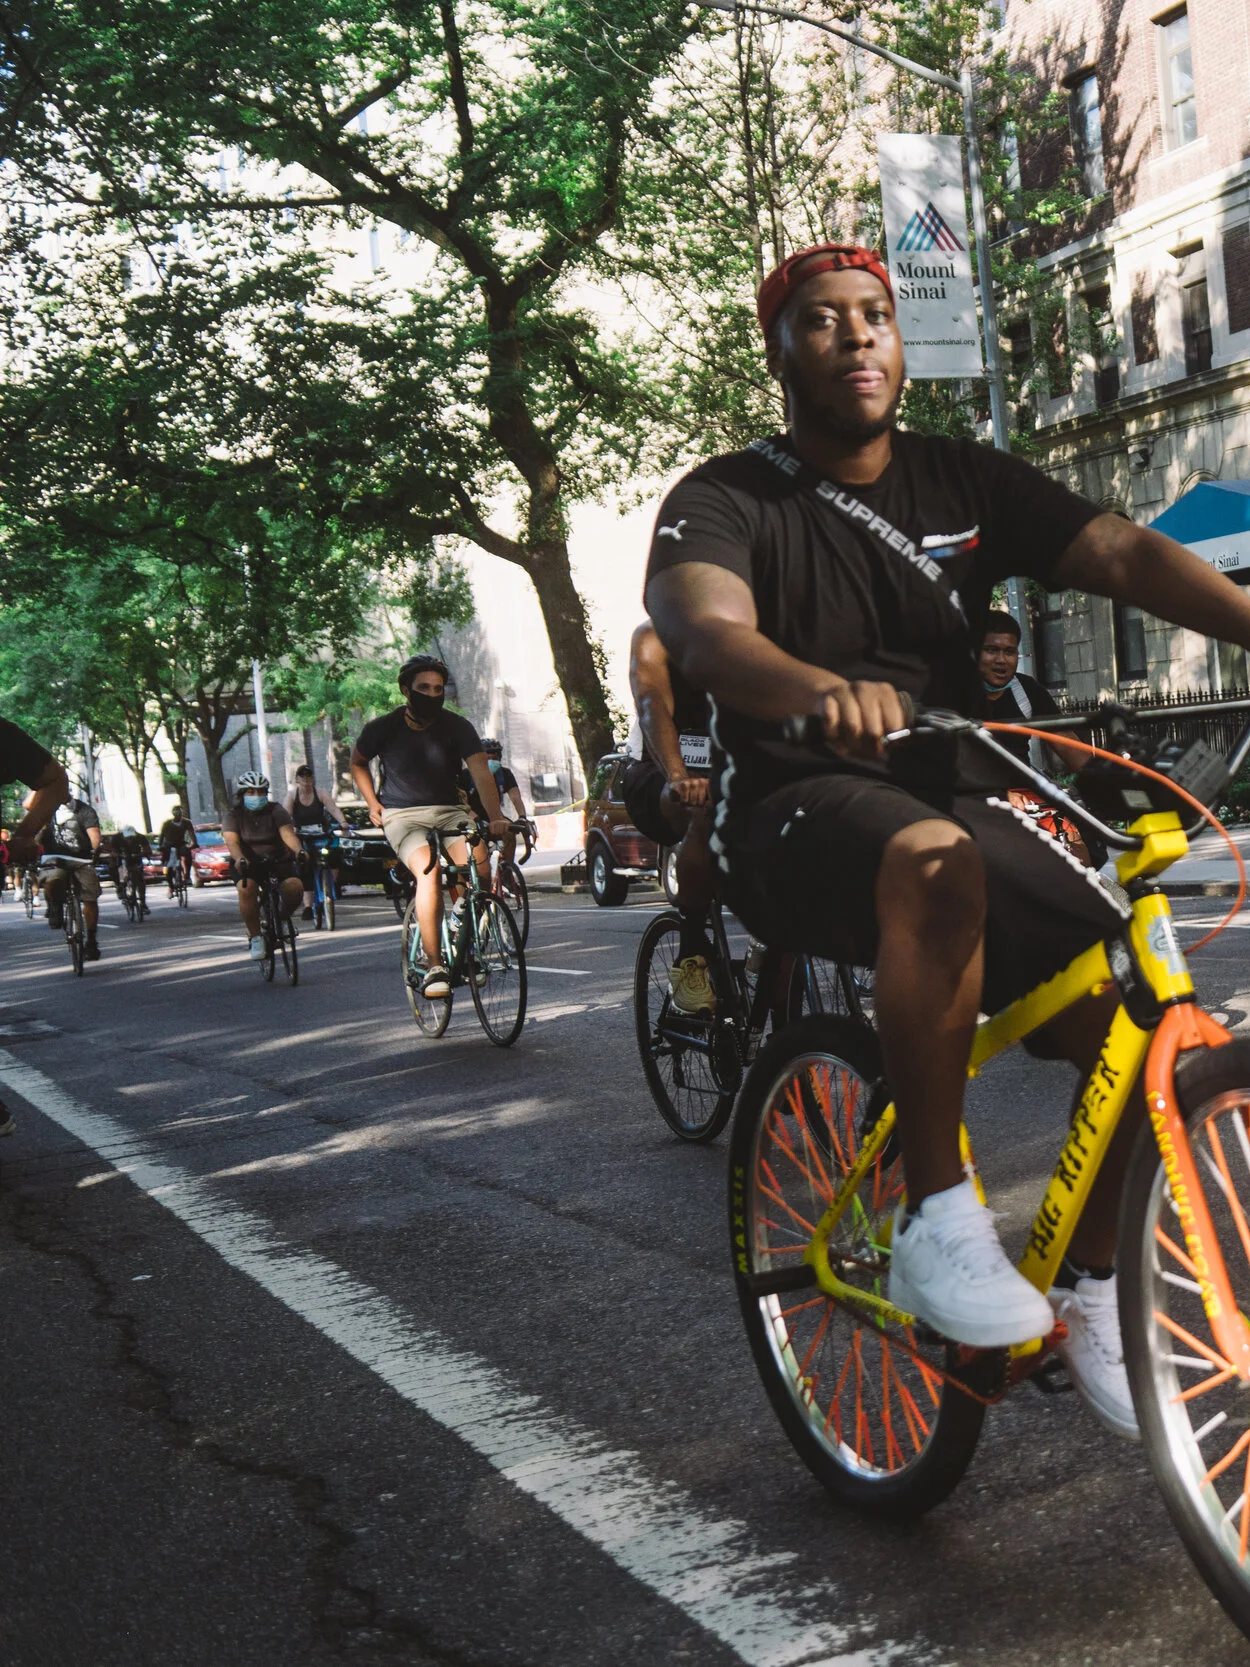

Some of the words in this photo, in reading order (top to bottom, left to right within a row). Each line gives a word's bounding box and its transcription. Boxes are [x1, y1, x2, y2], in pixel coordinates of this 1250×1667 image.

[896, 261, 957, 279] Mount
[898, 282, 947, 300] Sinai
[815, 480, 944, 582] SUPREME
[1218, 551, 1240, 569] Sinai
[683, 754, 708, 765] ELIJAH
[733, 1165, 749, 1274] MAXXIS
